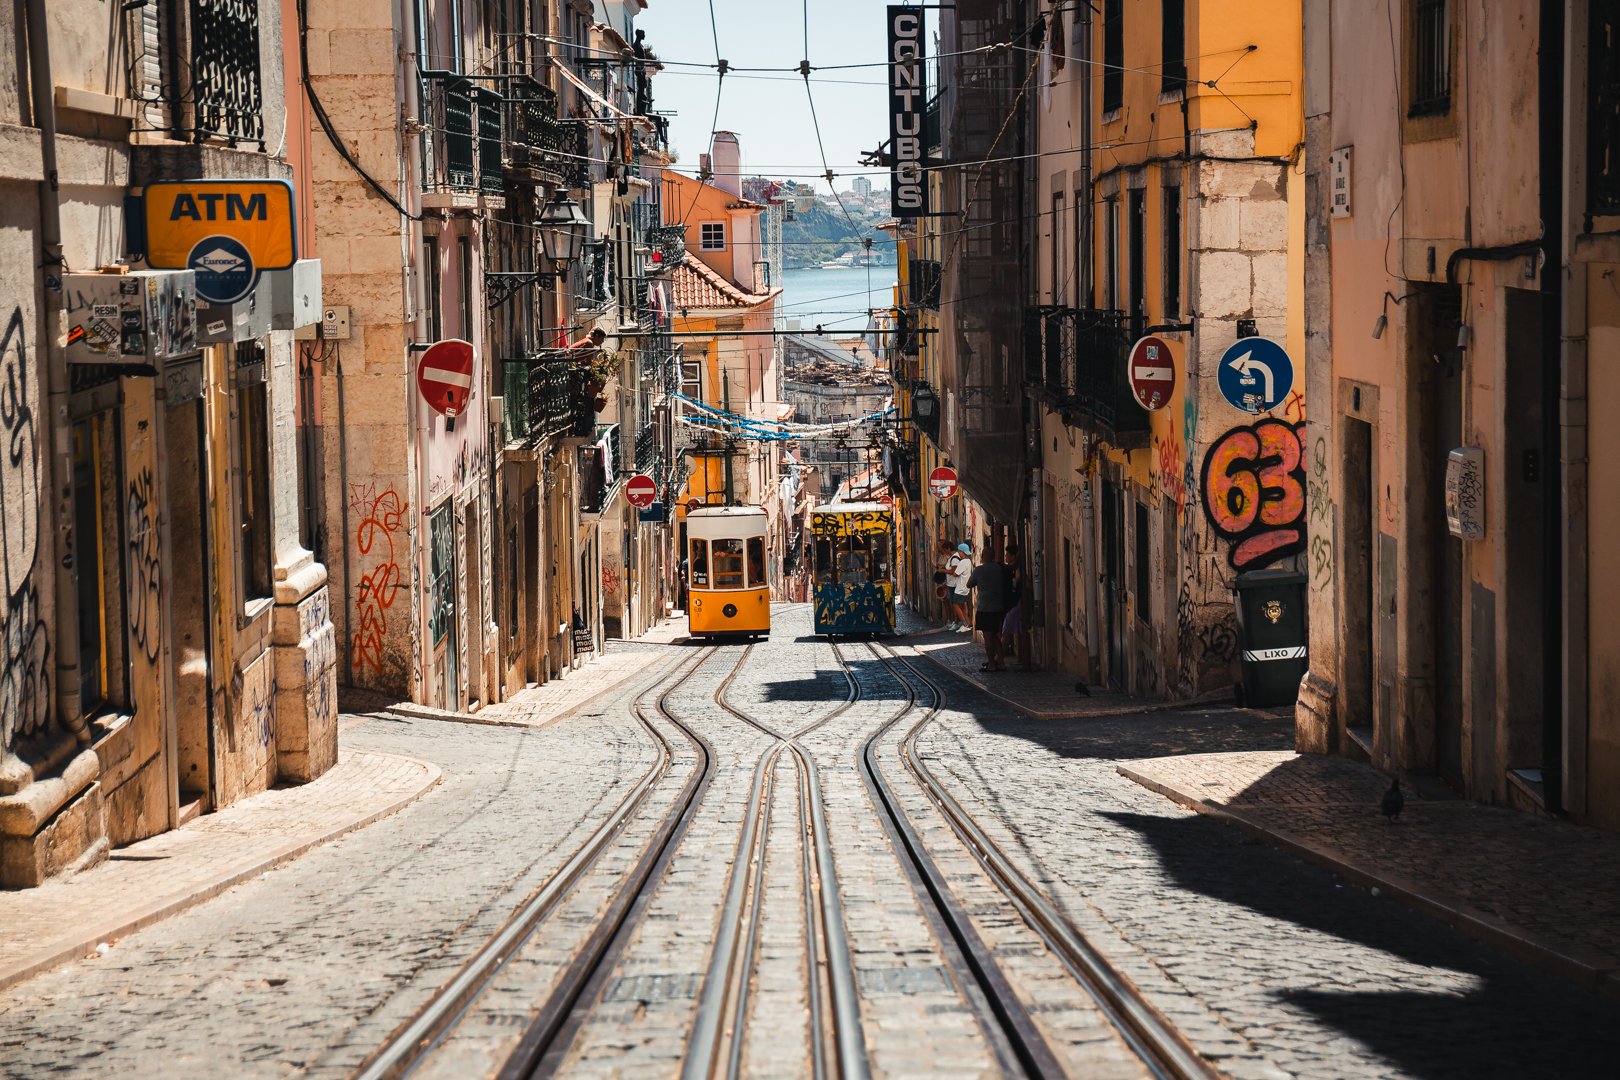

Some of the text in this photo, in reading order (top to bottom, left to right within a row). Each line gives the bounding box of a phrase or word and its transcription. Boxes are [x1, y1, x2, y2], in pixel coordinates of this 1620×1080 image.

[894, 14, 923, 208] CONTUBOS
[169, 193, 268, 222] ATM
[202, 256, 238, 265] Euronet
[94, 306, 118, 315] RESIN
[1200, 419, 1307, 540] 63
[1264, 649, 1289, 659] LIXO
